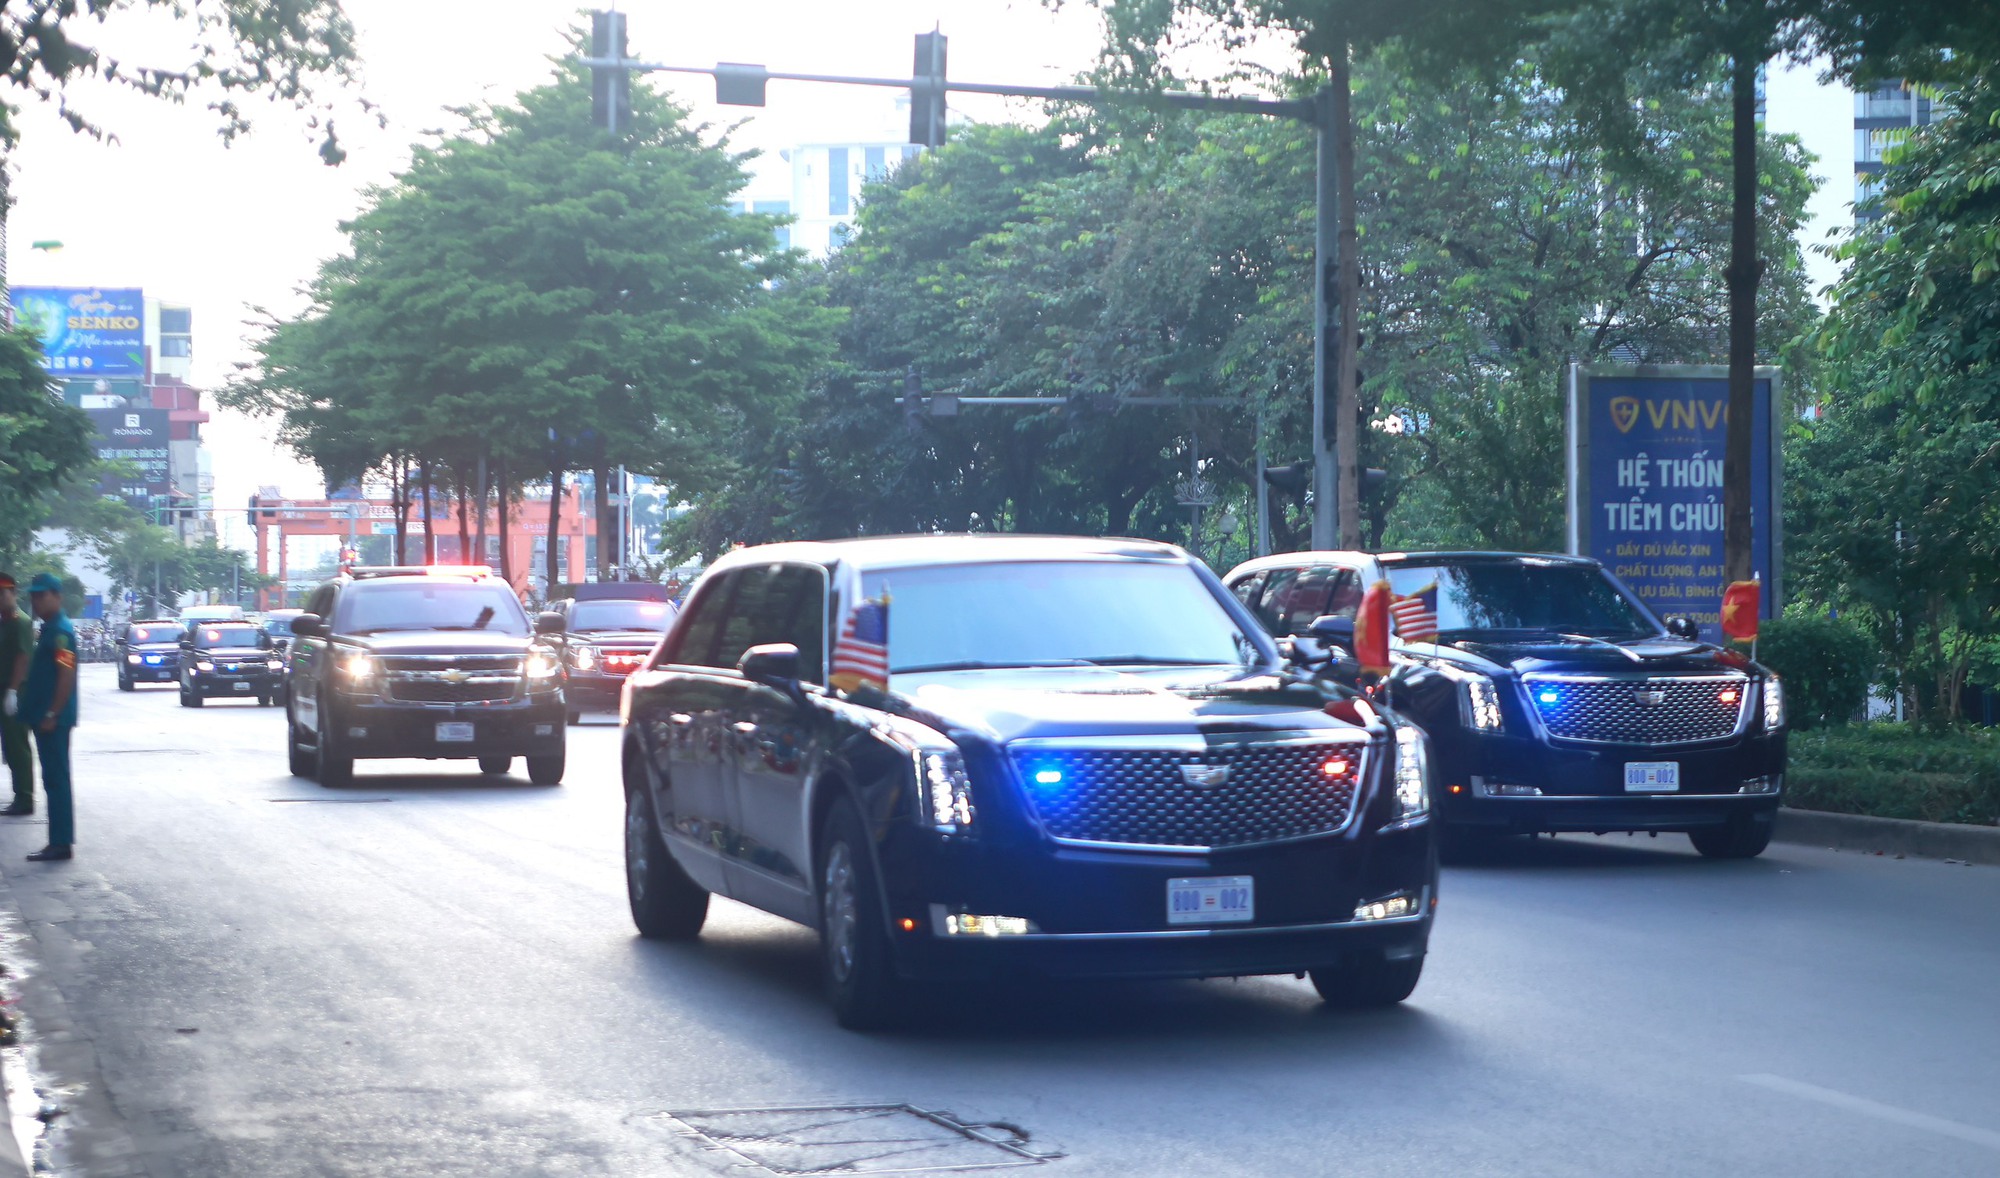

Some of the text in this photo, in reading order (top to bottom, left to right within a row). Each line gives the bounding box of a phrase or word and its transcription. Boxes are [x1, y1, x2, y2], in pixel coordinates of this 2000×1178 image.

[67, 316, 140, 330] SENKO
[1645, 399, 1729, 429] VNV
[113, 428, 153, 436] ROMANO
[1617, 450, 1724, 494] HỆ THỐN
[1603, 494, 1753, 531] TIÊM CHỦ
[1690, 545, 1711, 556] XIN
[1615, 561, 1648, 577] CHẤT
[1699, 565, 1717, 577] AN
[1656, 769, 1675, 784] 002
[1220, 887, 1248, 909] 002
